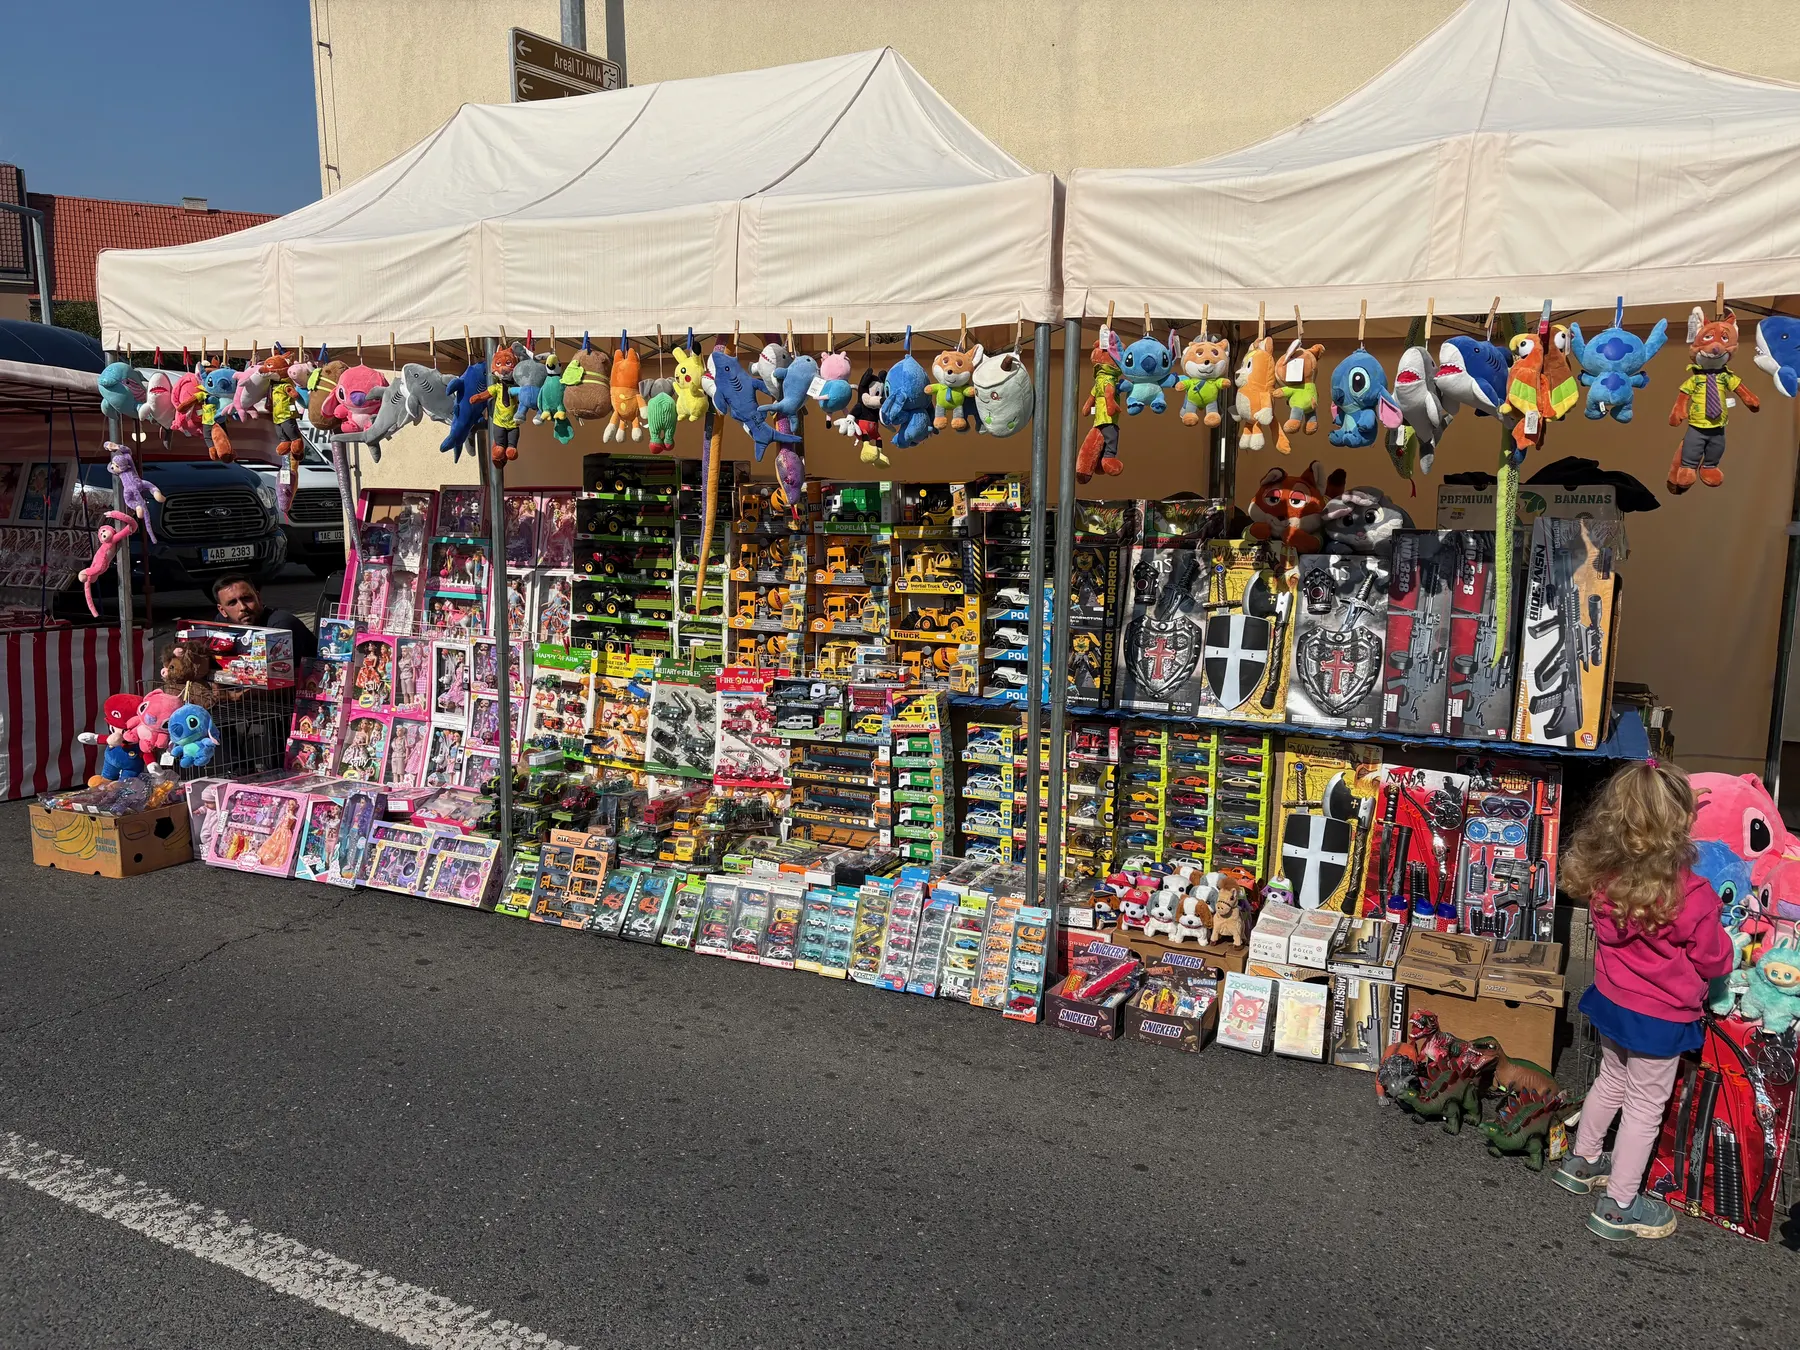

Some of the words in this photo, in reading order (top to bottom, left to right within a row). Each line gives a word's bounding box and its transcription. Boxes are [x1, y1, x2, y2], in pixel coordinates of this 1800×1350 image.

[554, 51, 575, 74] Areál
[575, 58, 584, 76] TJ
[585, 66, 602, 83] AVIA
[1440, 495, 1493, 504] PREMIUM
[1555, 495, 1612, 504] BANANAS
[214, 508, 229, 516] Ford
[210, 549, 226, 559] 4AB
[231, 547, 251, 557] 2383
[963, 547, 974, 590] TRUCK
[1399, 537, 1413, 593] NO.338
[1106, 550, 1118, 617] T-WARRIOR
[893, 631, 921, 639] TRUCK
[1101, 633, 1114, 699] T-WARRIOR
[653, 667, 678, 676] MILITARY
[682, 669, 701, 678] FORCES
[741, 677, 764, 685] ALARM
[839, 751, 870, 759] CONTAINER
[350, 756, 369, 768] Sally
[795, 771, 827, 781] FREIGHT
[1499, 775, 1533, 784] FORCE
[1501, 783, 1529, 792] POLICE
[839, 791, 871, 800] CONTAINER
[797, 811, 828, 821] FREIGHT
[1089, 941, 1127, 959] SNICKERS
[1163, 952, 1203, 969] SNICKERS
[1229, 980, 1270, 996] ZOOTOPIA
[1334, 976, 1348, 1010] AIRSOFT
[1060, 1009, 1097, 1027] SNICKERS
[1333, 1010, 1345, 1026] GUN
[1142, 1021, 1182, 1039] SNICKERS
